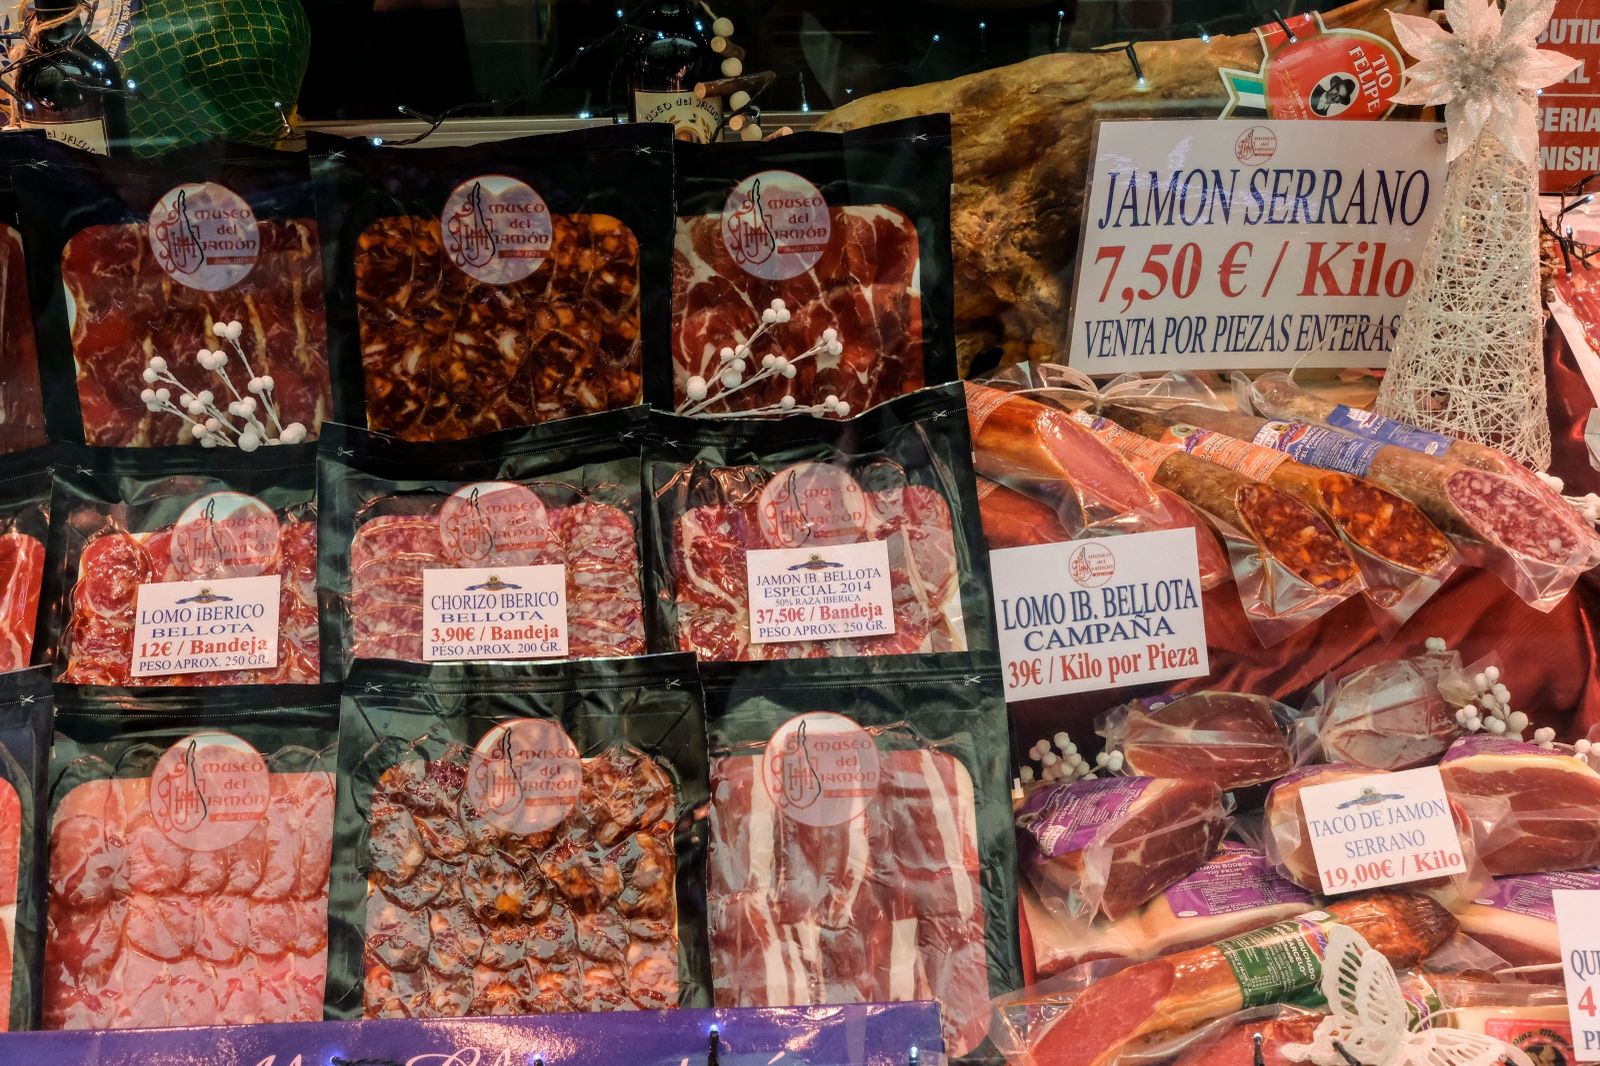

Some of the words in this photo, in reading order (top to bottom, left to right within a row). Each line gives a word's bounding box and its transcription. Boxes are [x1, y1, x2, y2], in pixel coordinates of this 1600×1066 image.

[1348, 46, 1381, 113] FELIPE
[1371, 53, 1393, 89] TIO
[1098, 168, 1241, 230] JAMON
[1244, 168, 1430, 227] SERRANO
[509, 219, 531, 229] del
[788, 213, 809, 224] del
[216, 224, 237, 235] del
[1094, 242, 1203, 314] 7,50
[1217, 241, 1254, 298] €
[1261, 241, 1290, 298] /
[1296, 242, 1416, 298] Kilo
[1084, 319, 1156, 359] VENTA
[1157, 316, 1207, 357] POR
[1214, 314, 1293, 354] PIEZAS
[756, 574, 801, 586] JAMON
[823, 567, 882, 581] BELLOTA
[764, 584, 837, 598] ESPECIAL
[841, 580, 872, 593] 2014
[431, 593, 497, 611] CHORIZO
[501, 591, 559, 609] IBERICO
[795, 597, 820, 606] RAZA
[1001, 592, 1066, 631] LOMO
[1069, 590, 1098, 622] IB.
[1101, 577, 1199, 619] BELLOTA
[141, 608, 192, 625] LOMO
[441, 611, 544, 623] BELLOTA
[756, 606, 806, 626] 37,50€
[810, 606, 815, 621] /
[820, 602, 883, 621] Bandeja
[152, 623, 255, 639] BELLOTA
[431, 626, 475, 644] 3,90€
[480, 626, 486, 641] /
[491, 624, 559, 642] Bandeja
[759, 626, 791, 638] PESO
[793, 623, 840, 636] APROX.
[844, 621, 863, 633] 250
[865, 620, 887, 631] GR.
[1024, 612, 1175, 652] CAMPAÑA
[140, 641, 173, 658] 12€
[177, 641, 184, 655] /
[190, 636, 268, 656] Bandeja
[432, 645, 464, 656] PESO
[467, 643, 514, 655] APROX.
[518, 643, 537, 654] 200
[540, 641, 562, 652] GR.
[139, 660, 172, 672] PESO
[174, 657, 221, 670] APROX.
[225, 655, 245, 667] 250
[1008, 658, 1044, 689] 39€
[1049, 656, 1055, 684] /
[1059, 652, 1103, 682] Kilo
[1106, 653, 1142, 684] por
[1146, 642, 1199, 671] Pieza
[836, 755, 857, 767] del
[223, 778, 247, 790] del
[1310, 813, 1356, 838] TACO
[1359, 809, 1384, 829] DE
[1388, 798, 1446, 825] JAMON
[1344, 829, 1425, 859] SERRANO
[1323, 859, 1395, 889] 19,00€
[1401, 856, 1406, 876] /
[1411, 850, 1461, 873] Kilo
